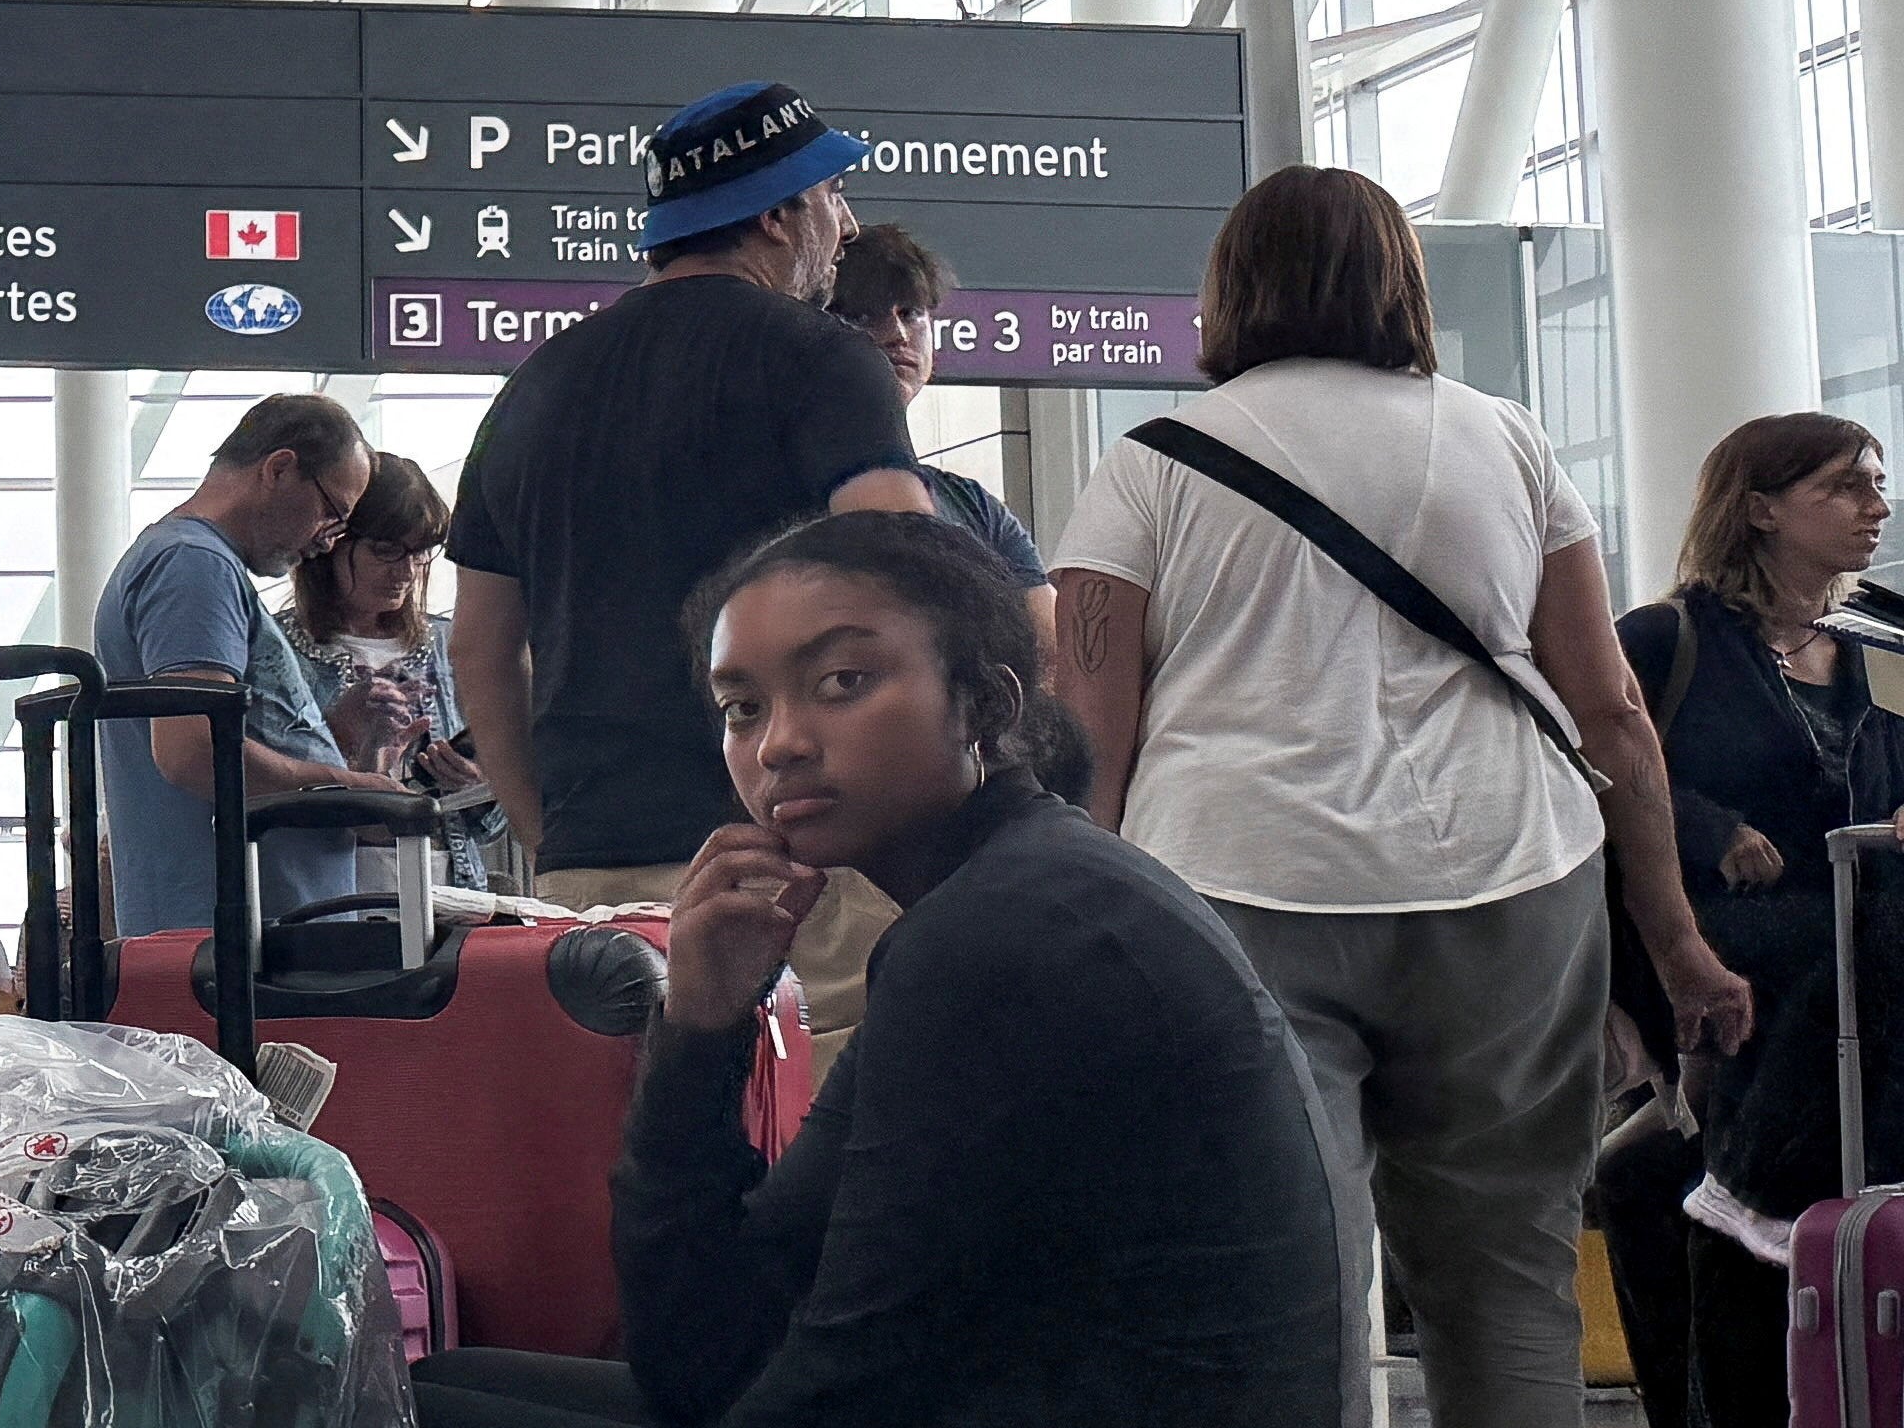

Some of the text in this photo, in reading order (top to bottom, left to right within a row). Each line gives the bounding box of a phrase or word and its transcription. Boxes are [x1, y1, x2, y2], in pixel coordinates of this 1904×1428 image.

[470, 115, 510, 169] P
[546, 123, 663, 166] Park
[551, 205, 617, 230] Train
[552, 236, 618, 262] Train
[402, 302, 429, 339] 3
[467, 300, 599, 343] Term
[993, 310, 1022, 353] 3
[1051, 305, 1149, 334] by train
[1052, 340, 1162, 366] par train
